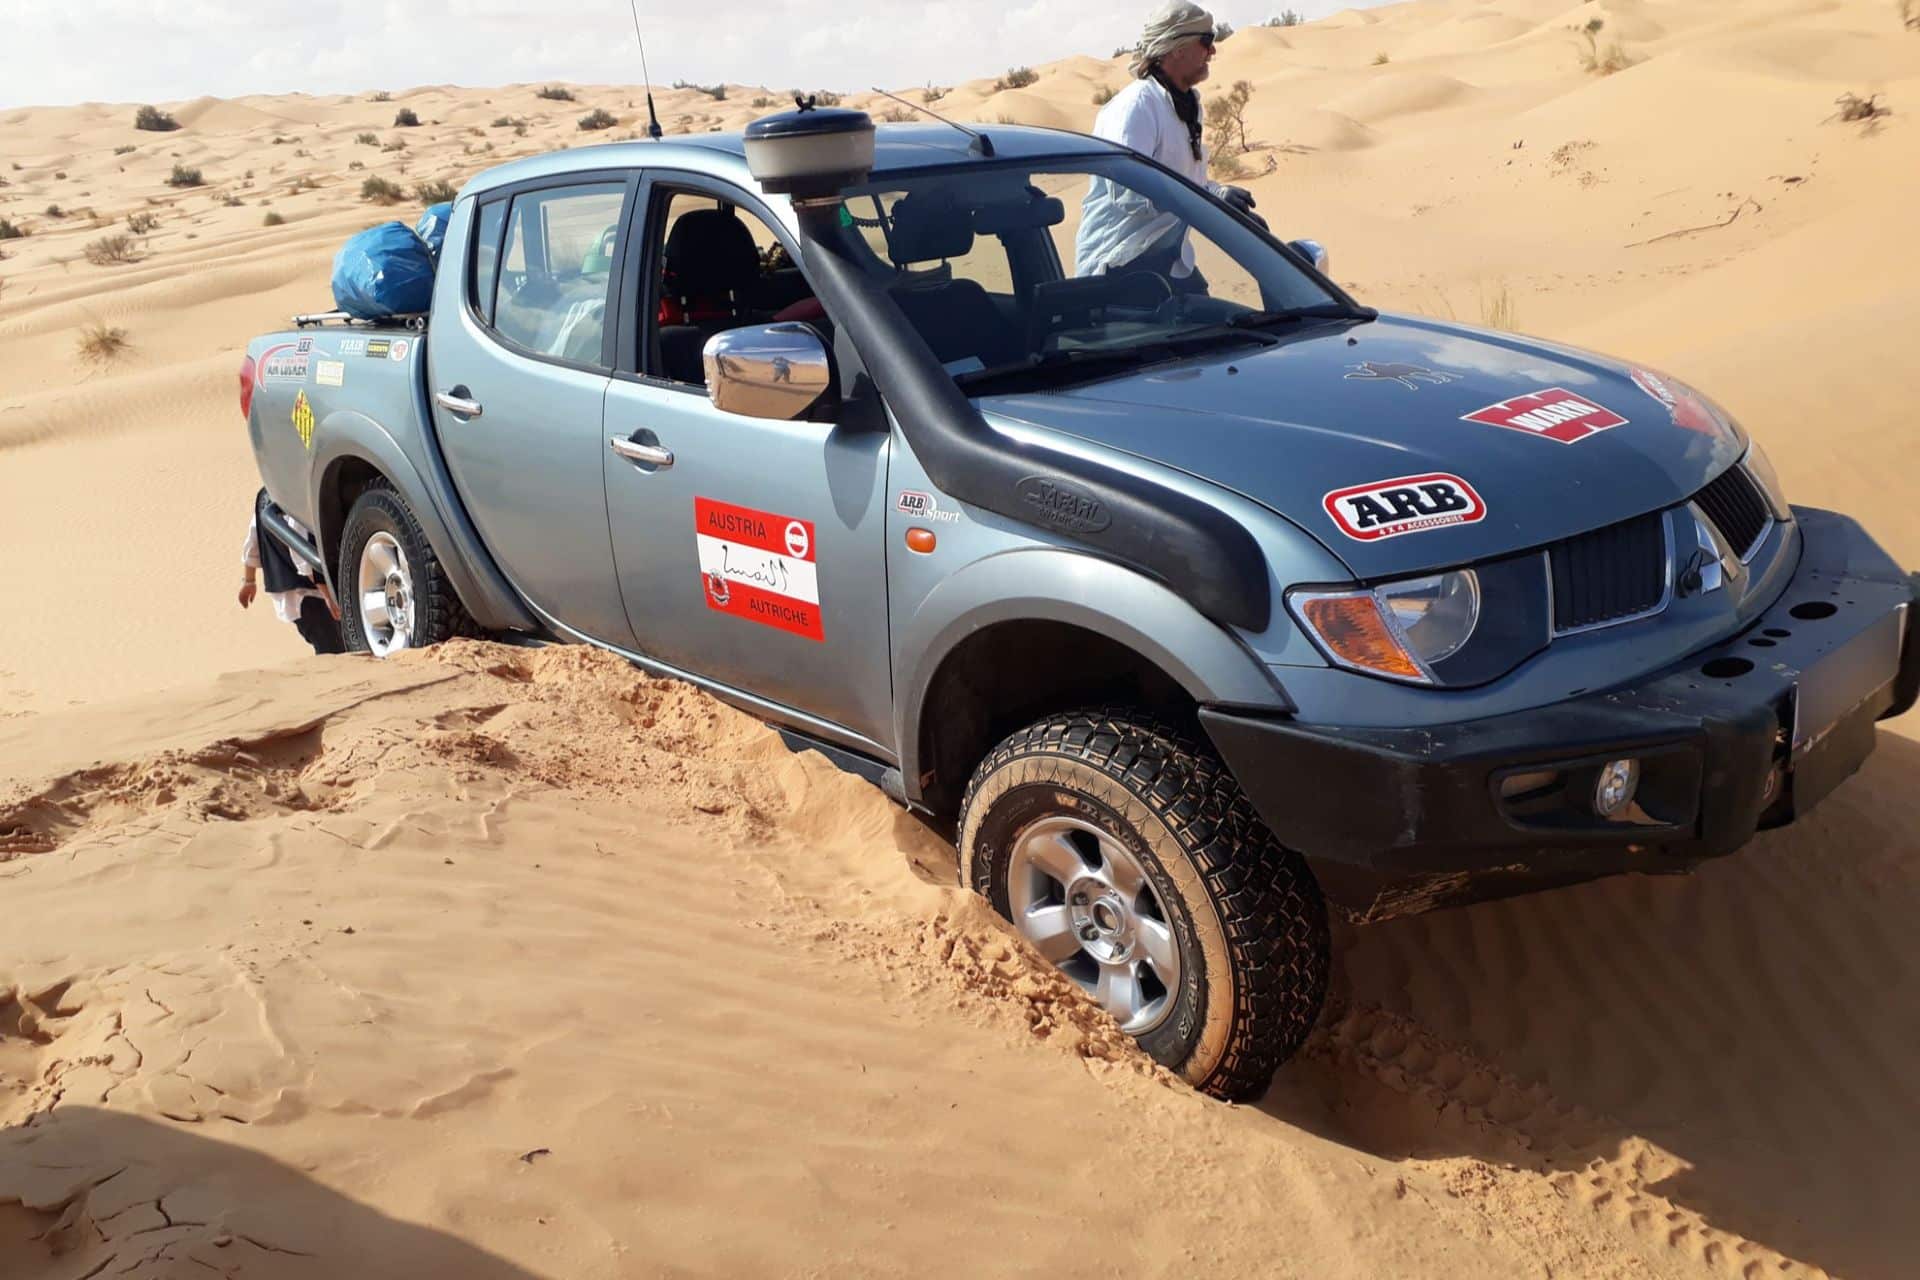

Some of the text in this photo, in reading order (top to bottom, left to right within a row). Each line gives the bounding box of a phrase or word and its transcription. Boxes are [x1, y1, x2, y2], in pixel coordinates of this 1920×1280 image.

[1506, 399, 1600, 432] WARN
[900, 495, 924, 509] ARB
[1347, 483, 1468, 528] ARB
[709, 511, 767, 539] AUSTRIA
[1407, 514, 1465, 530] ACCESSORIES
[750, 599, 809, 626] AUTRICHE
